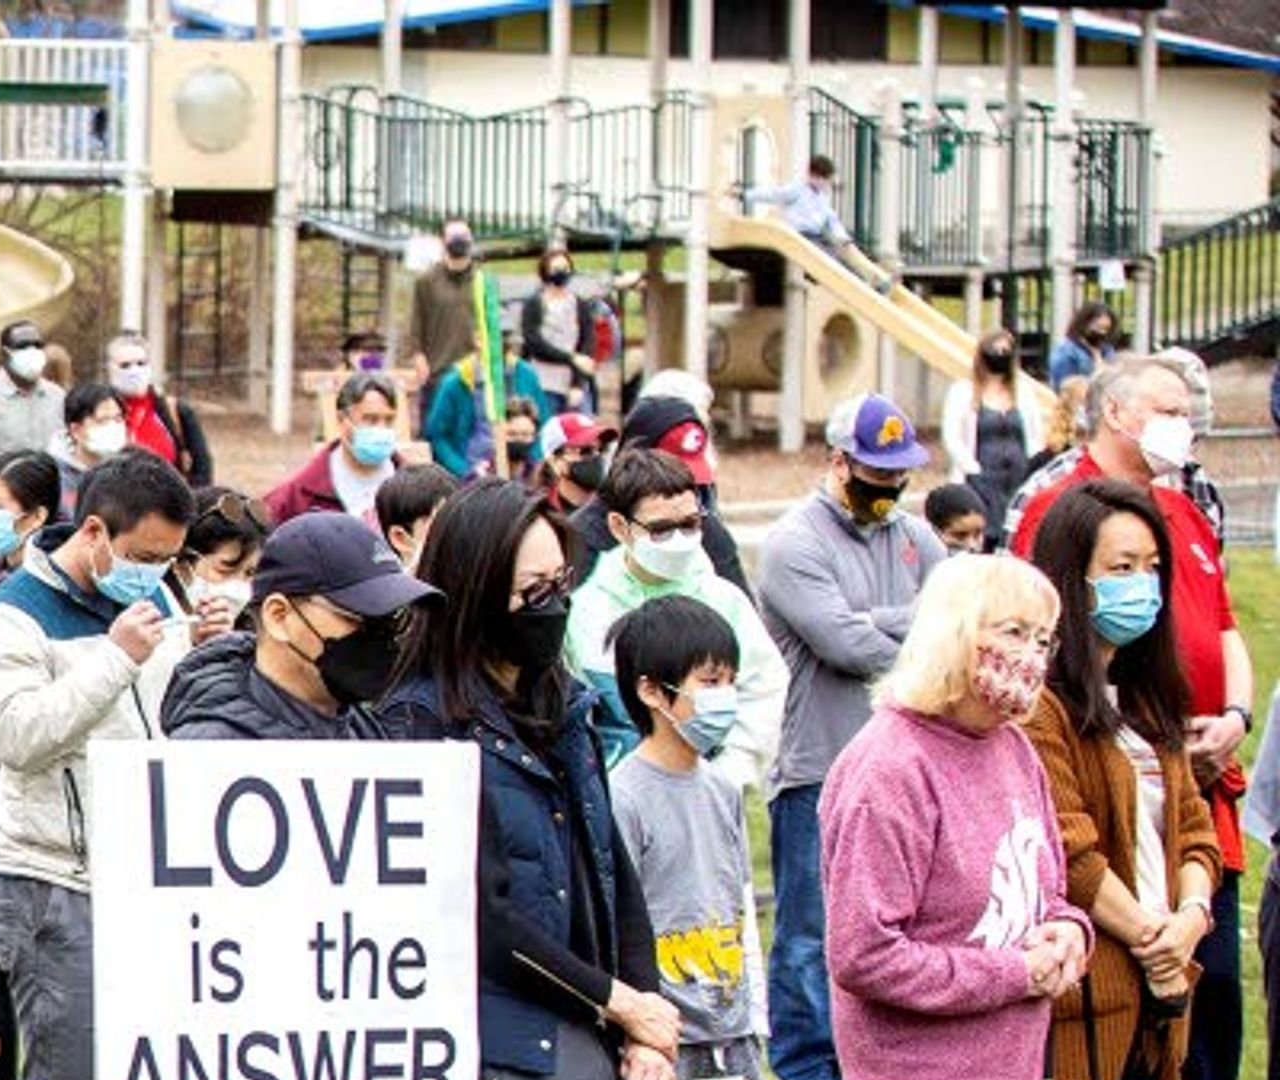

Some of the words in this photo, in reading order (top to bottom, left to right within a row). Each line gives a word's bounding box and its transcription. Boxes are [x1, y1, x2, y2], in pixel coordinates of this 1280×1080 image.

[147, 759, 427, 888] LOVE
[190, 912, 245, 1003] is
[308, 911, 428, 1002] the
